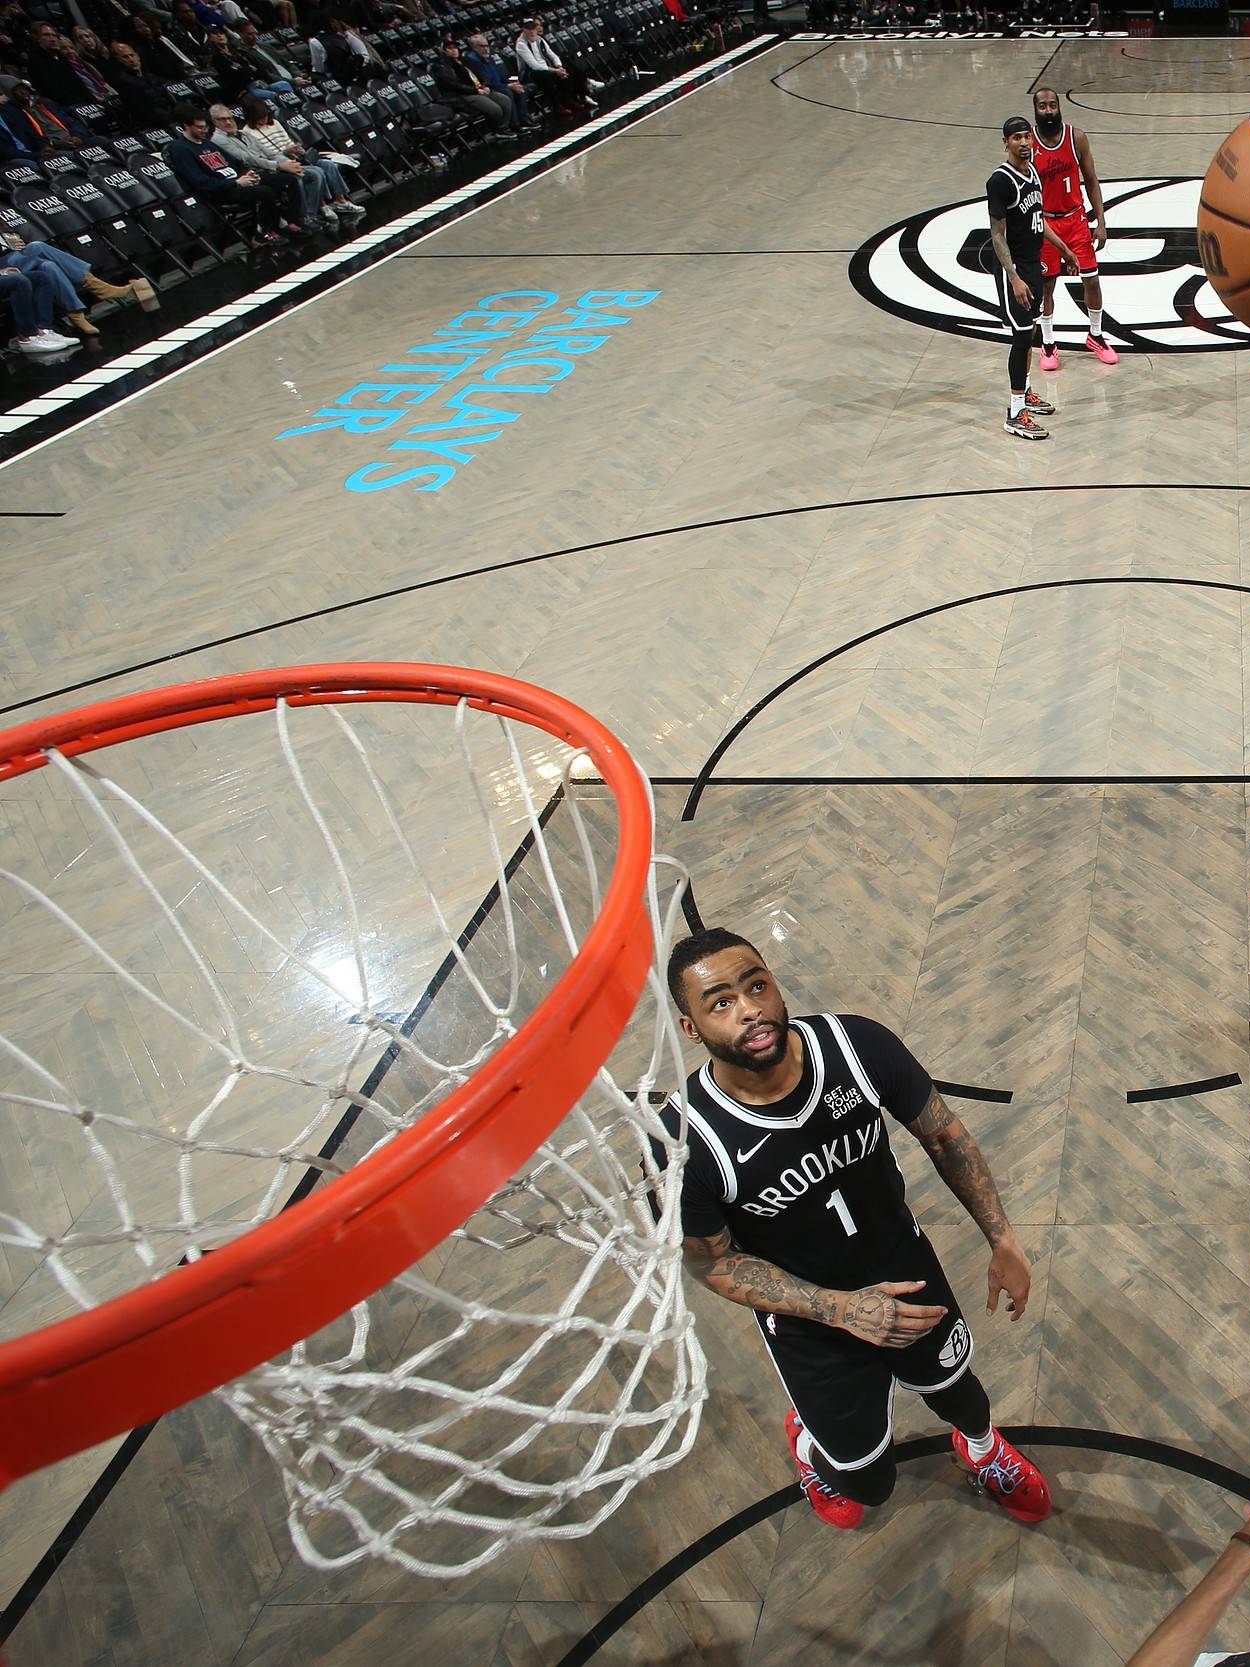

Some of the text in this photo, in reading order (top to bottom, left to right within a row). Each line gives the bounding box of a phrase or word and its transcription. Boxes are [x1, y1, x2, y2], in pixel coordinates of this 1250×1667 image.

[789, 31, 1003, 40] Brooklyn
[1019, 30, 1129, 38] Nets
[44, 156, 73, 170] QATAR
[141, 162, 170, 177] QATAR
[5, 166, 35, 181] QATAR
[104, 171, 135, 187] QATAR
[66, 183, 98, 200] QATAR
[1063, 176, 1071, 193] 1
[28, 195, 64, 212] QATAR
[1031, 211, 1043, 234] 45
[273, 290, 559, 441] CENTER
[343, 289, 663, 492] BARCLAYS
[824, 1085, 843, 1103] GET
[827, 1087, 858, 1111] YOUR
[832, 1093, 863, 1119] GUIDE
[741, 1117, 881, 1218] BROOKLYN
[825, 1188, 858, 1237] 1
